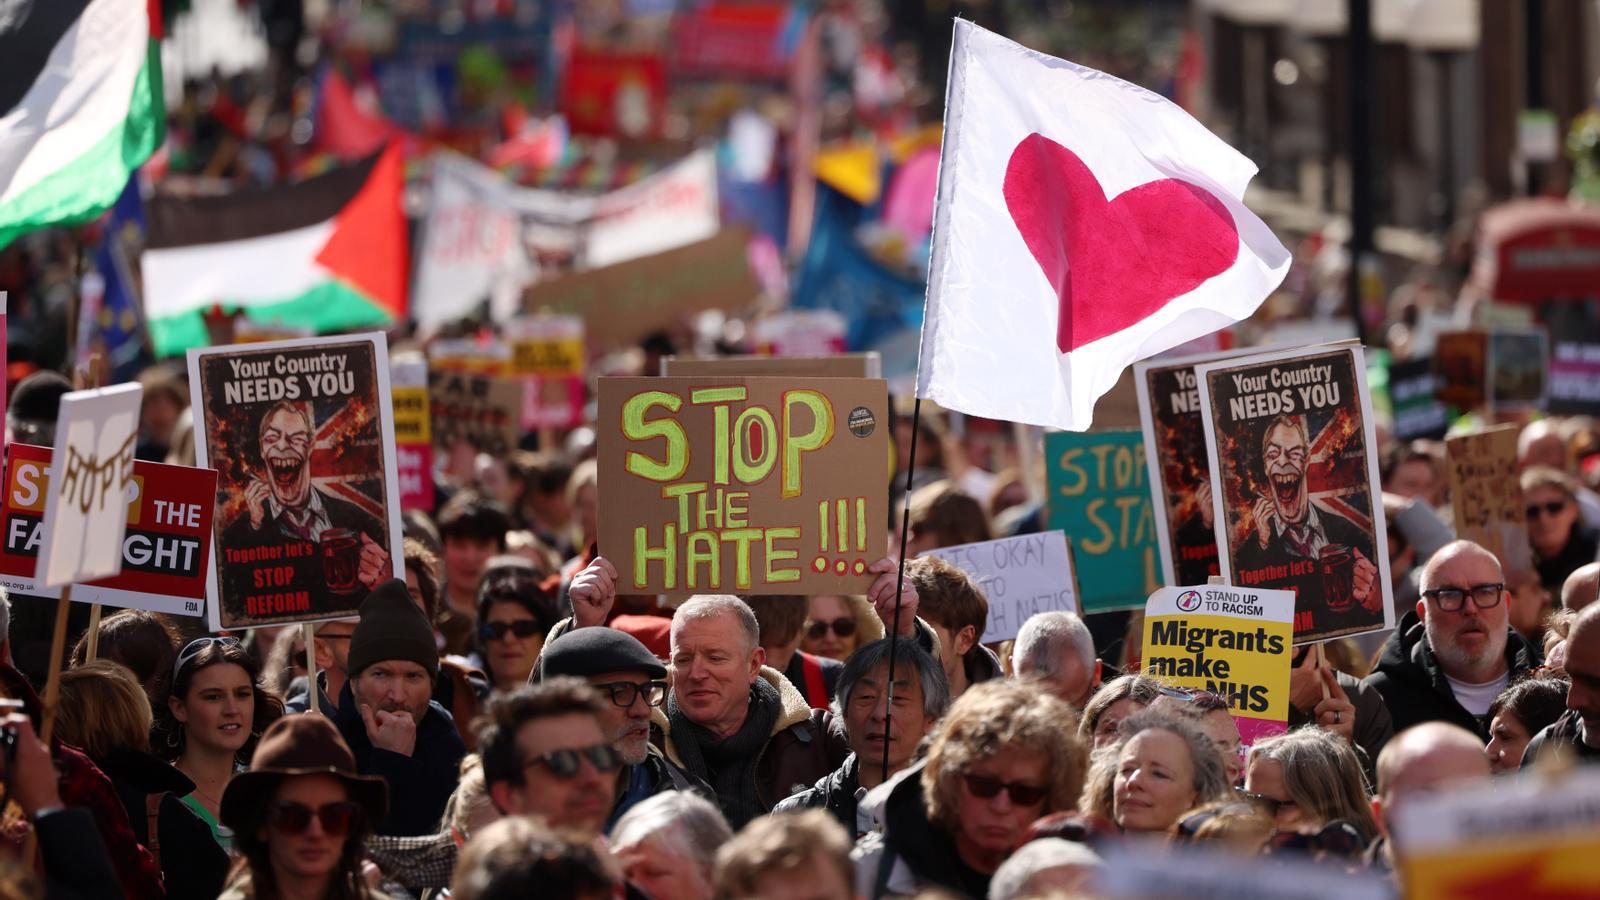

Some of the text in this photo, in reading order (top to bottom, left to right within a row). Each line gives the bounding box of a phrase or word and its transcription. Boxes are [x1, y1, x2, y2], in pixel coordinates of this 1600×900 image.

[229, 353, 347, 379] Your Country
[1174, 371, 1197, 390] YO
[1232, 364, 1332, 394] Your Country
[224, 371, 355, 405] NEEDS YOU
[1229, 388, 1296, 421] NEEDS
[1298, 381, 1341, 410] YOU
[620, 385, 835, 499] STOP
[61, 440, 135, 514] HOPE
[154, 500, 202, 528] THE
[662, 481, 750, 534] THE
[1081, 496, 1156, 555] STA
[123, 534, 199, 571] GHT
[225, 545, 282, 563] Together
[633, 497, 867, 590] HATE !!!
[993, 535, 1048, 570] OKAY
[253, 566, 295, 588] STOP
[979, 575, 1006, 597] TO
[1239, 564, 1288, 585] Together
[1289, 560, 1314, 575] let's
[185, 602, 198, 612] FDA
[246, 591, 310, 616] REFORM
[1205, 590, 1258, 605] STAND UP
[1205, 601, 1263, 616] TO RACISM
[1151, 620, 1284, 654] Migrants
[1149, 653, 1230, 679] make
[1206, 680, 1269, 713] NHS
